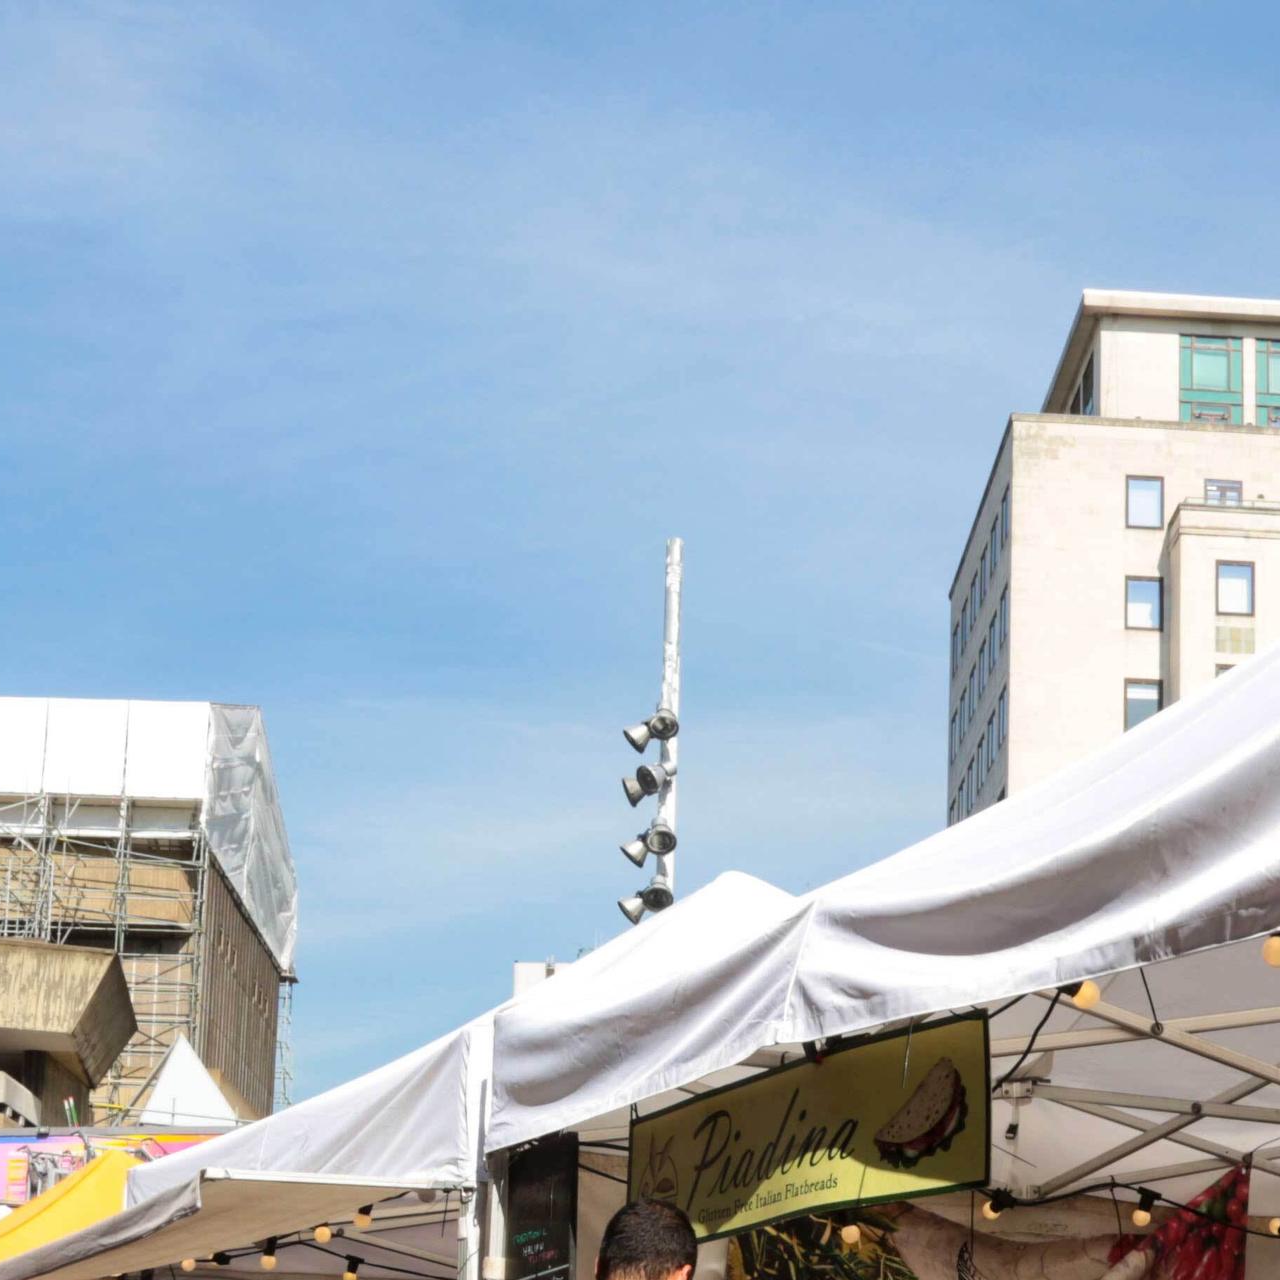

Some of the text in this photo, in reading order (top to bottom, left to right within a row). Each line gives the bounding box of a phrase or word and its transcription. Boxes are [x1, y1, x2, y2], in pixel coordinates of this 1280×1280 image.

[687, 1087, 860, 1212] Piadina
[734, 1198, 754, 1214] Free
[755, 1191, 782, 1209] Italian
[785, 1173, 839, 1200] Flatbreads
